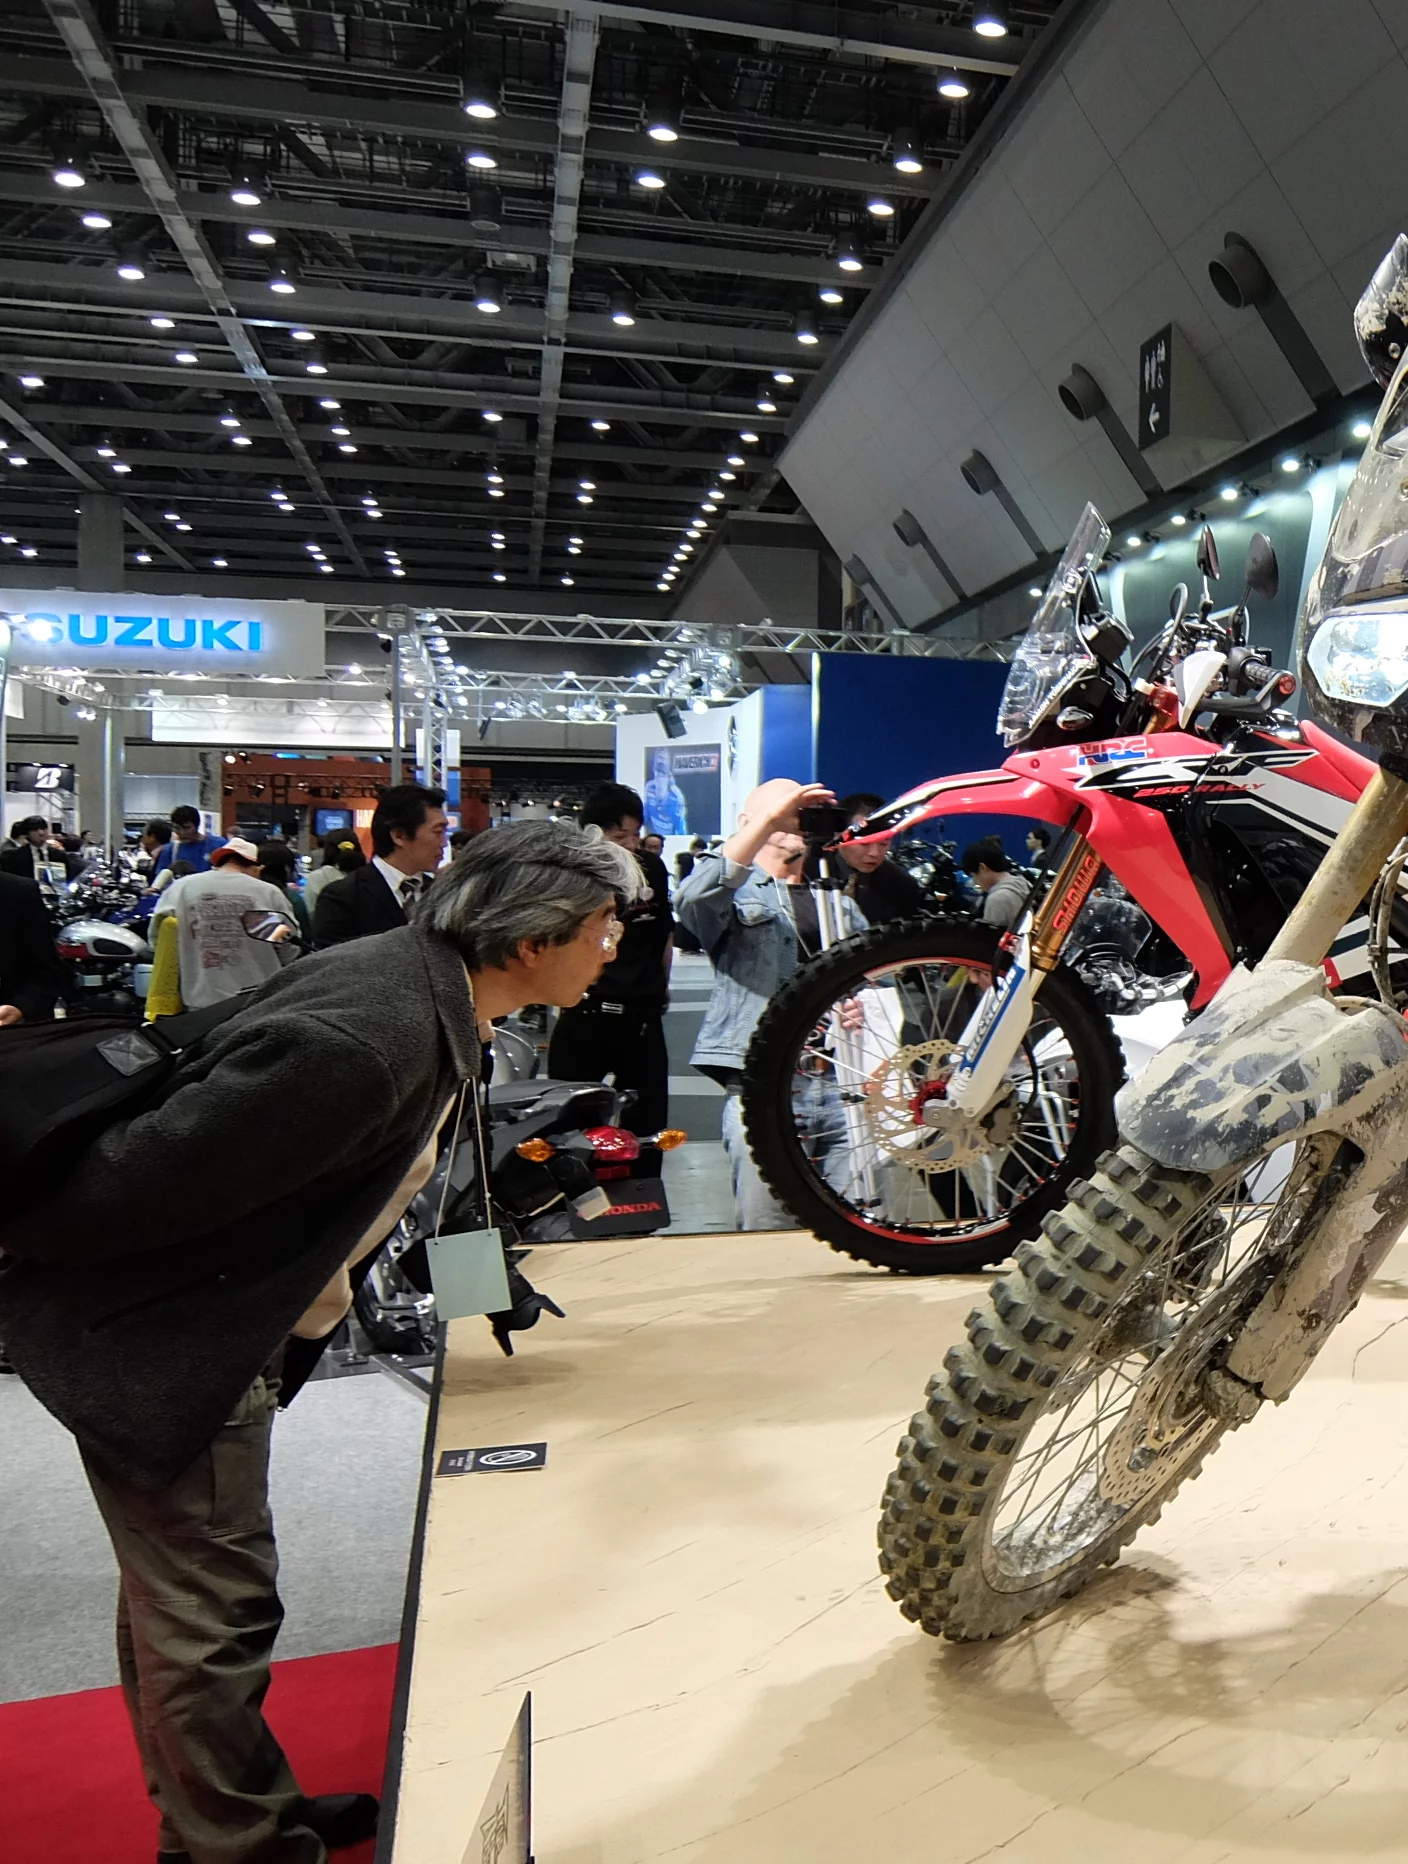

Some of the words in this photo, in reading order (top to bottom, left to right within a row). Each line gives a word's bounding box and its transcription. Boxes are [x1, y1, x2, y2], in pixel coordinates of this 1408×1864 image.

[1133, 785, 1189, 798] 250
[1194, 783, 1266, 793] RALLY
[1052, 855, 1101, 935] SHOWA
